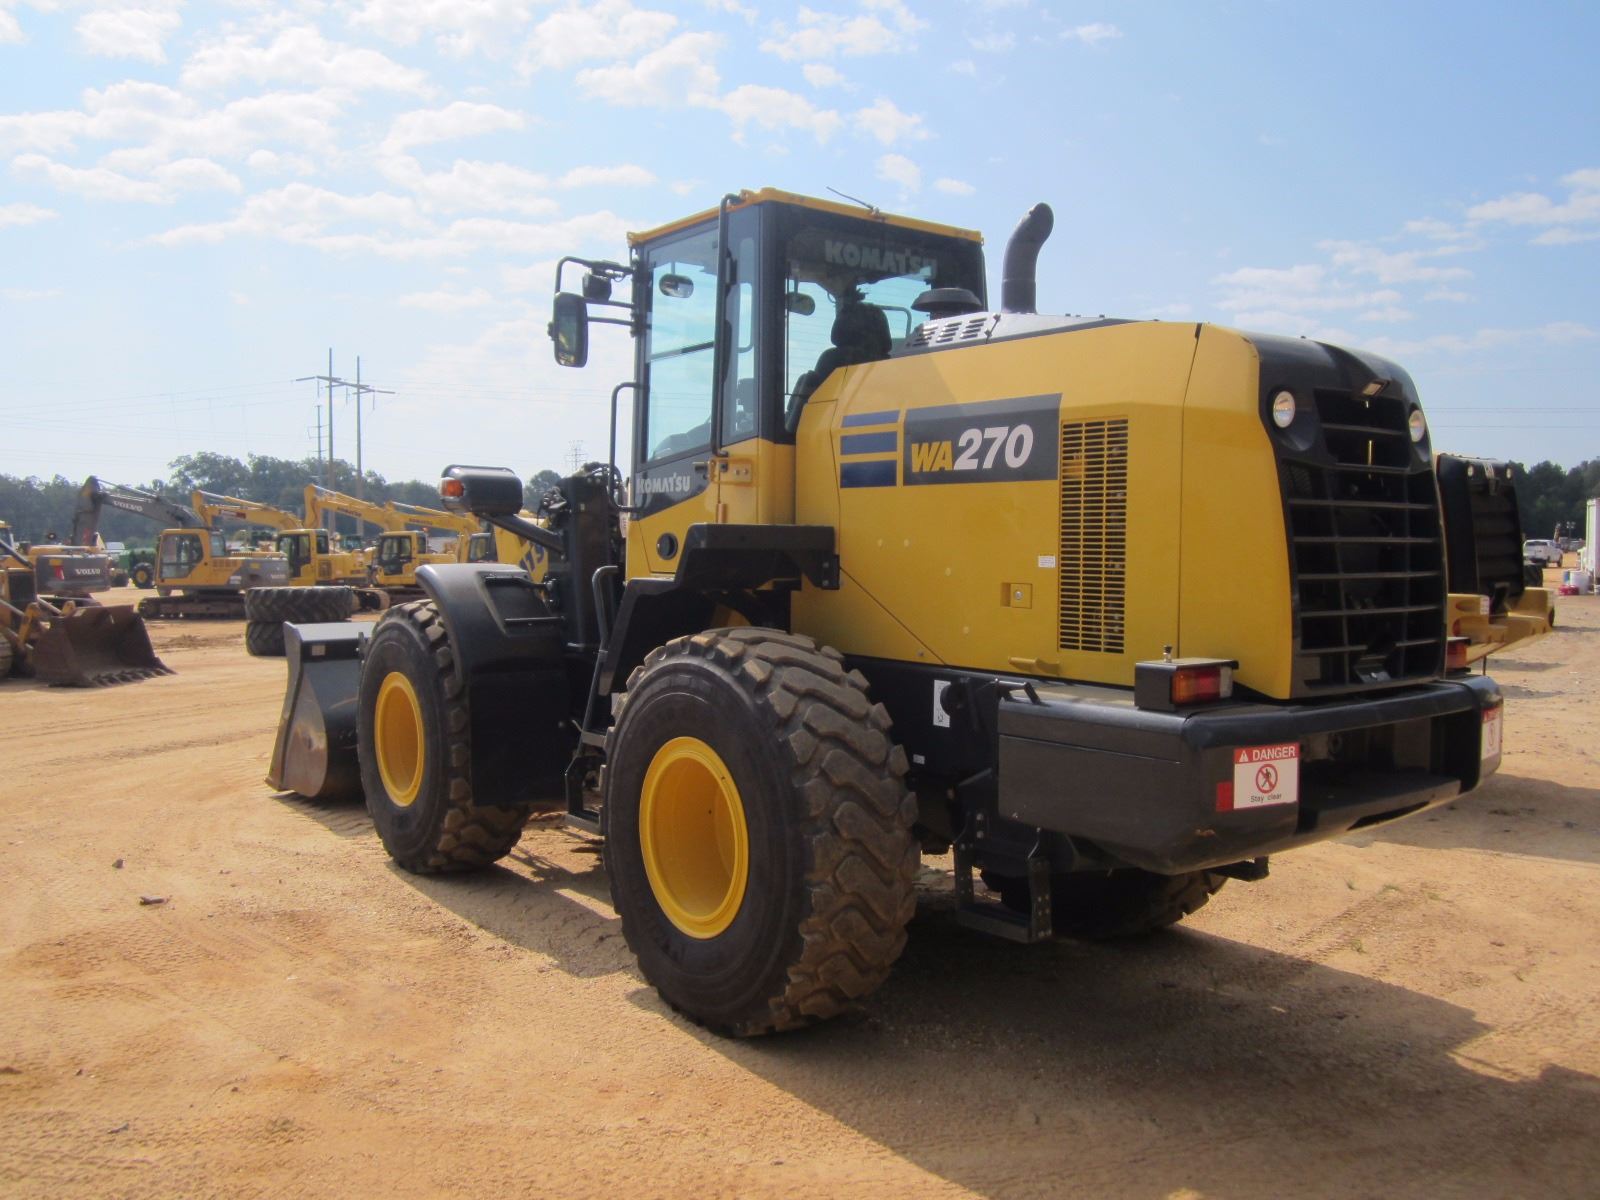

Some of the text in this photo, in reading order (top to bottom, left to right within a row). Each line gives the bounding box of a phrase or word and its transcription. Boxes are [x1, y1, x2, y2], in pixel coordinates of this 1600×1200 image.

[636, 472, 691, 495] KOMATSU
[112, 500, 143, 512] VOLVO
[75, 568, 101, 576] VOLVO
[1252, 746, 1296, 761] DANGER
[1250, 795, 1264, 803] Stay
